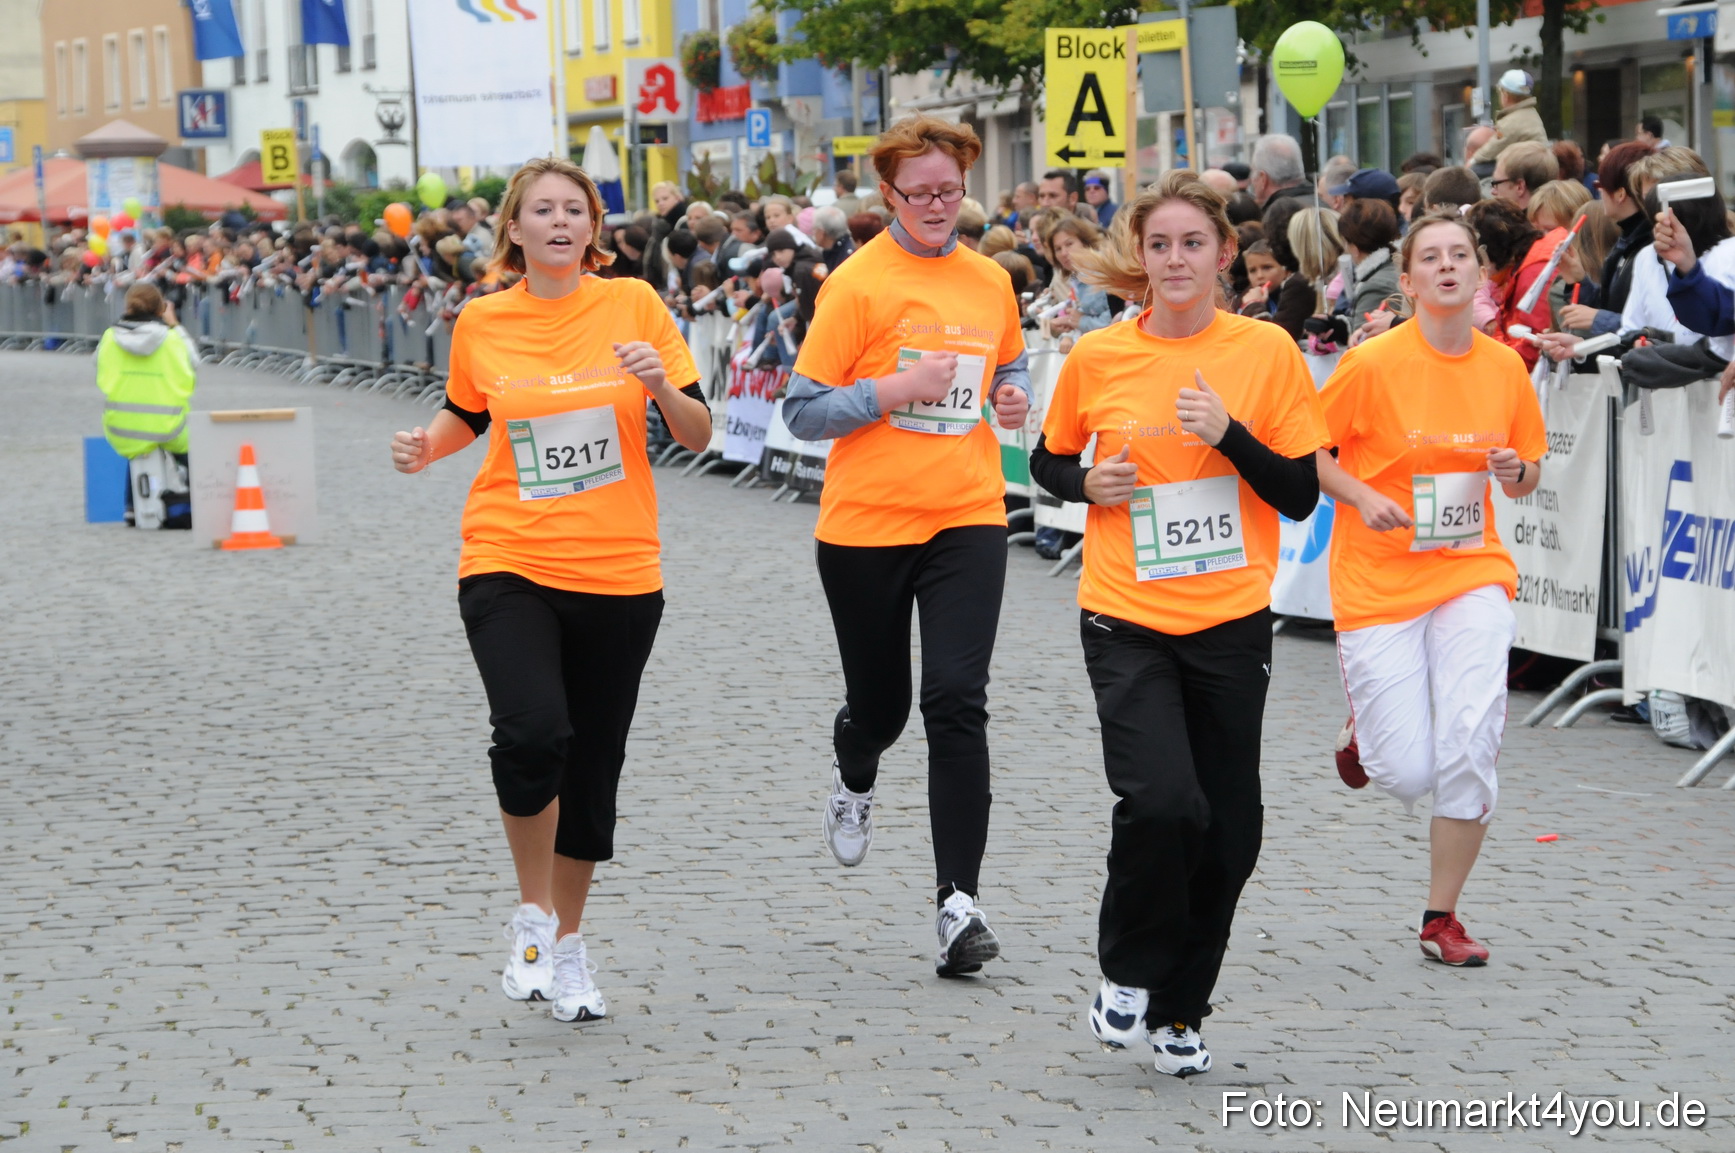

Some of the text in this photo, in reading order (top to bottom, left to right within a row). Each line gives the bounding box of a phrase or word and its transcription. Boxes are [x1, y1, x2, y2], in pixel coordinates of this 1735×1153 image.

[1057, 35, 1126, 59] Block
[1137, 30, 1176, 44] oiletten
[1065, 72, 1115, 136] A
[751, 113, 766, 144] P
[270, 145, 289, 171] B
[911, 322, 995, 342] stark ausbildung
[510, 365, 625, 391] stark ausbildung
[921, 387, 973, 410] 12
[1139, 422, 1177, 437] stark
[1422, 432, 1451, 445] stark
[546, 438, 609, 470] 5217
[584, 469, 623, 485] PFLEIDERER
[1441, 502, 1481, 527] 5216
[1166, 513, 1233, 547] 5215
[1515, 515, 1537, 545] der
[1207, 554, 1245, 567] PFLEIDERER
